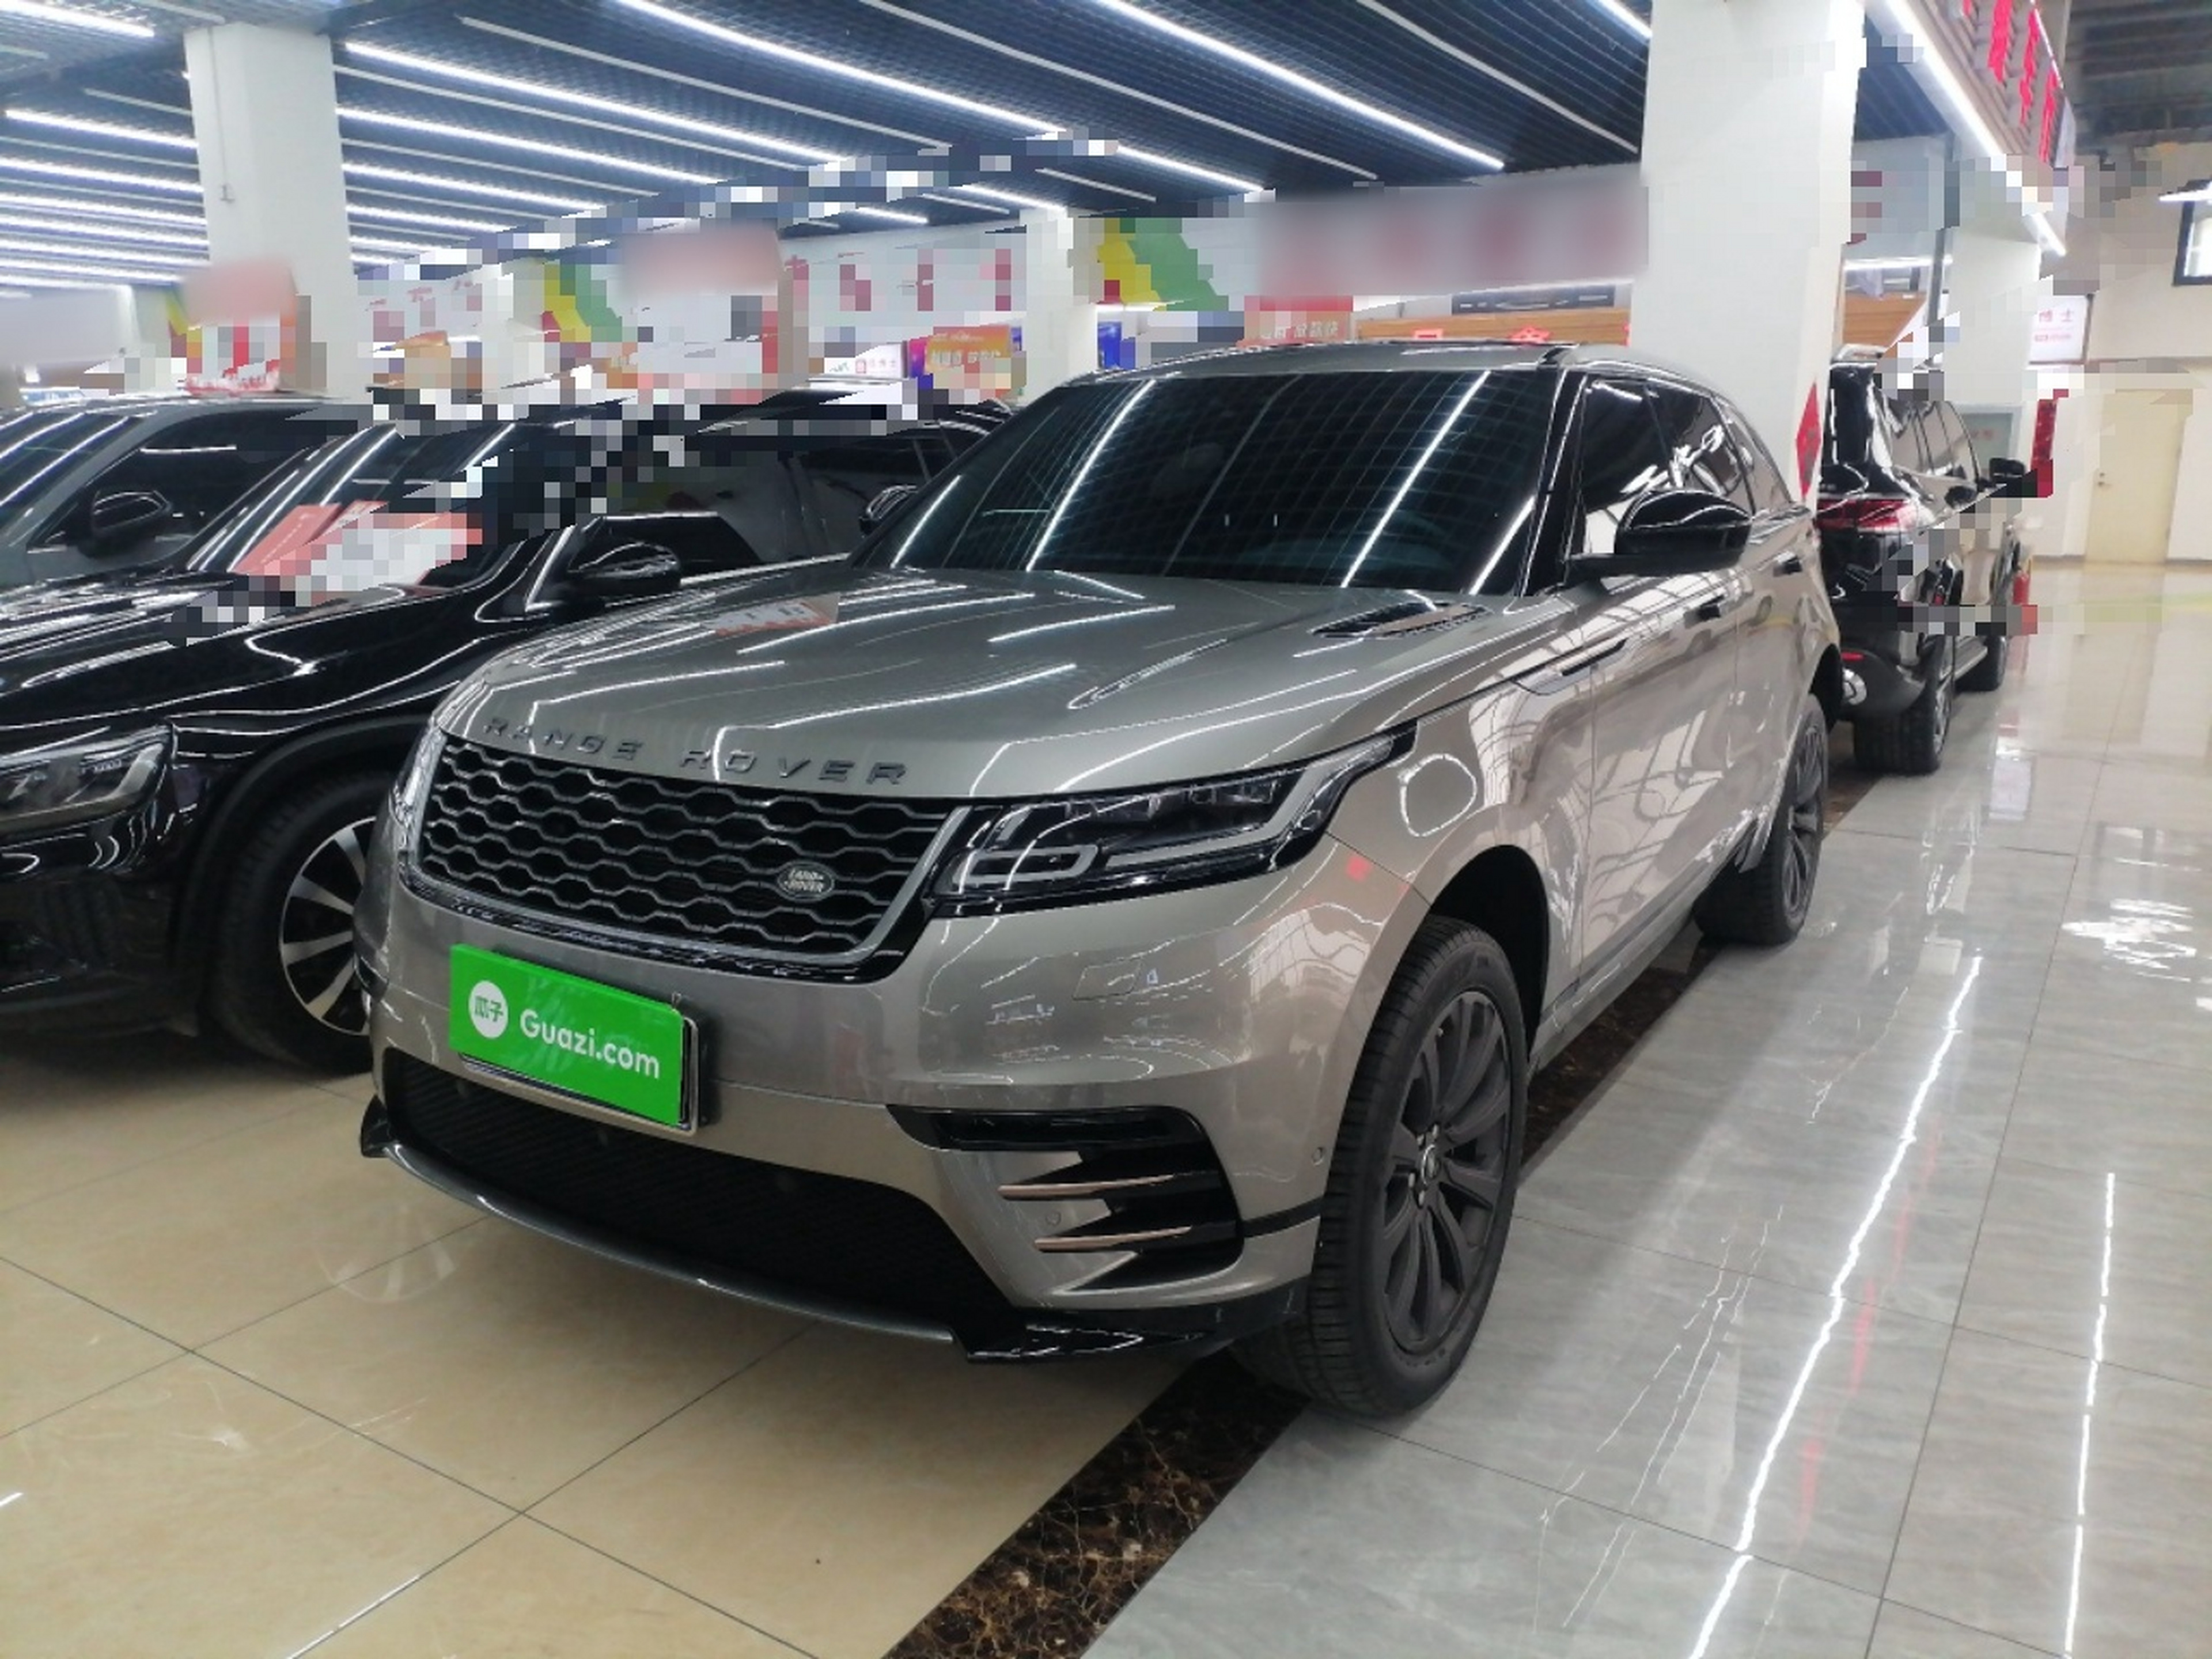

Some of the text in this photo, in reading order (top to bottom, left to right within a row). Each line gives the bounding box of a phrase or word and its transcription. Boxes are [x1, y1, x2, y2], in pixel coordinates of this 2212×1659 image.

[483, 717, 906, 785] RANGE ROVER
[474, 995, 504, 1022] 瓜子
[520, 1009, 660, 1080] Guazi.com
